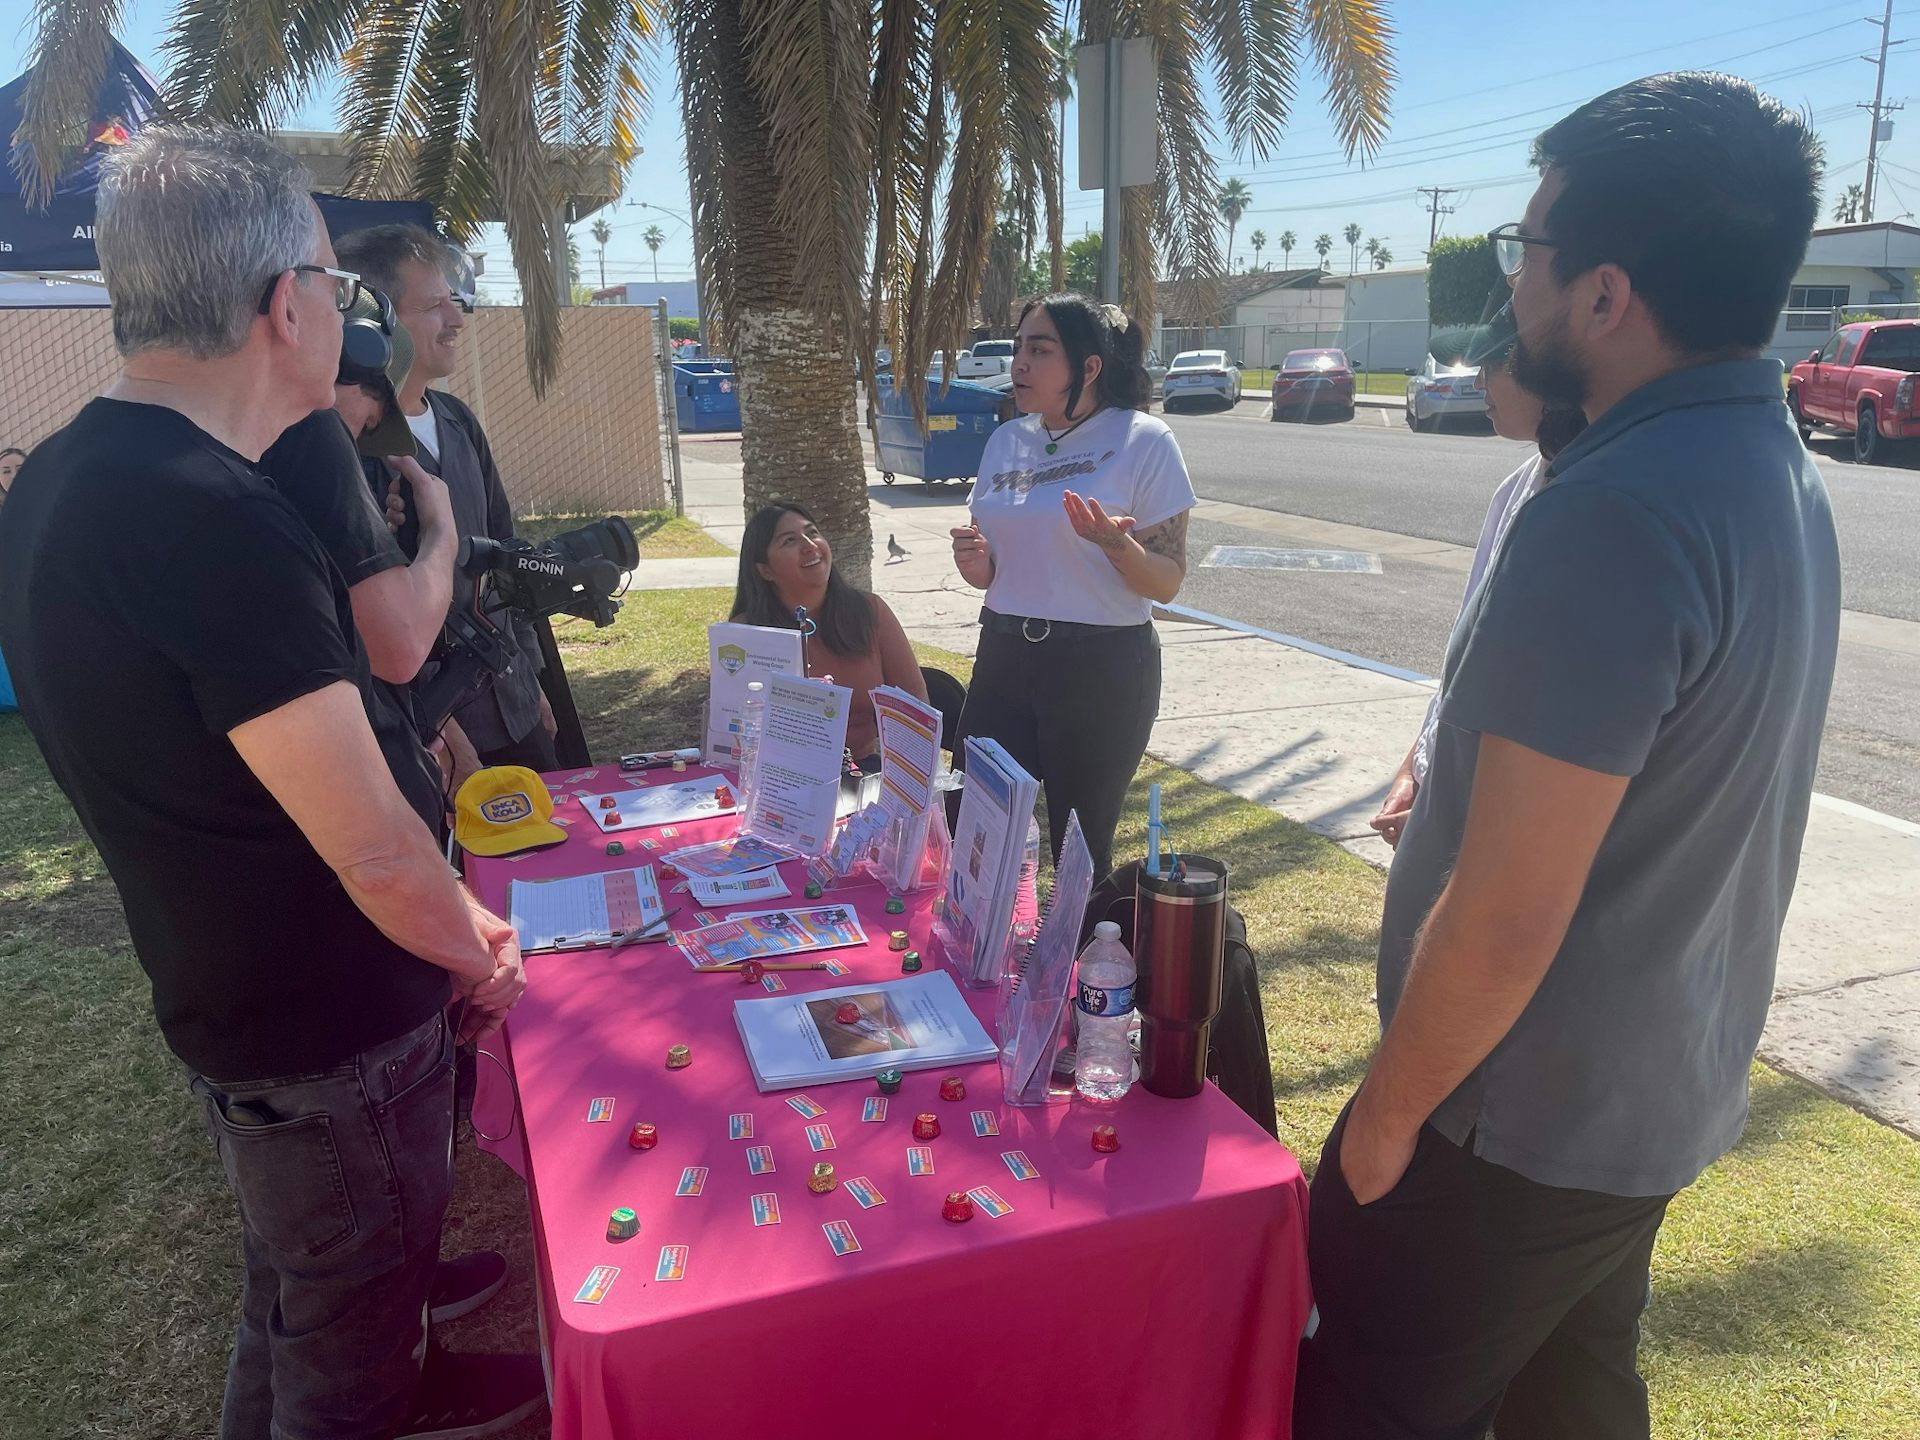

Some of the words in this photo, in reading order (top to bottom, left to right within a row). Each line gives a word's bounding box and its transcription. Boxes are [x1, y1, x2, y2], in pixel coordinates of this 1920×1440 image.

[518, 557, 564, 577] RONIN
[491, 800, 520, 811] INCA
[492, 806, 525, 818] KOLA
[1083, 985, 1103, 998] Pure
[1084, 993, 1100, 1006] Life
